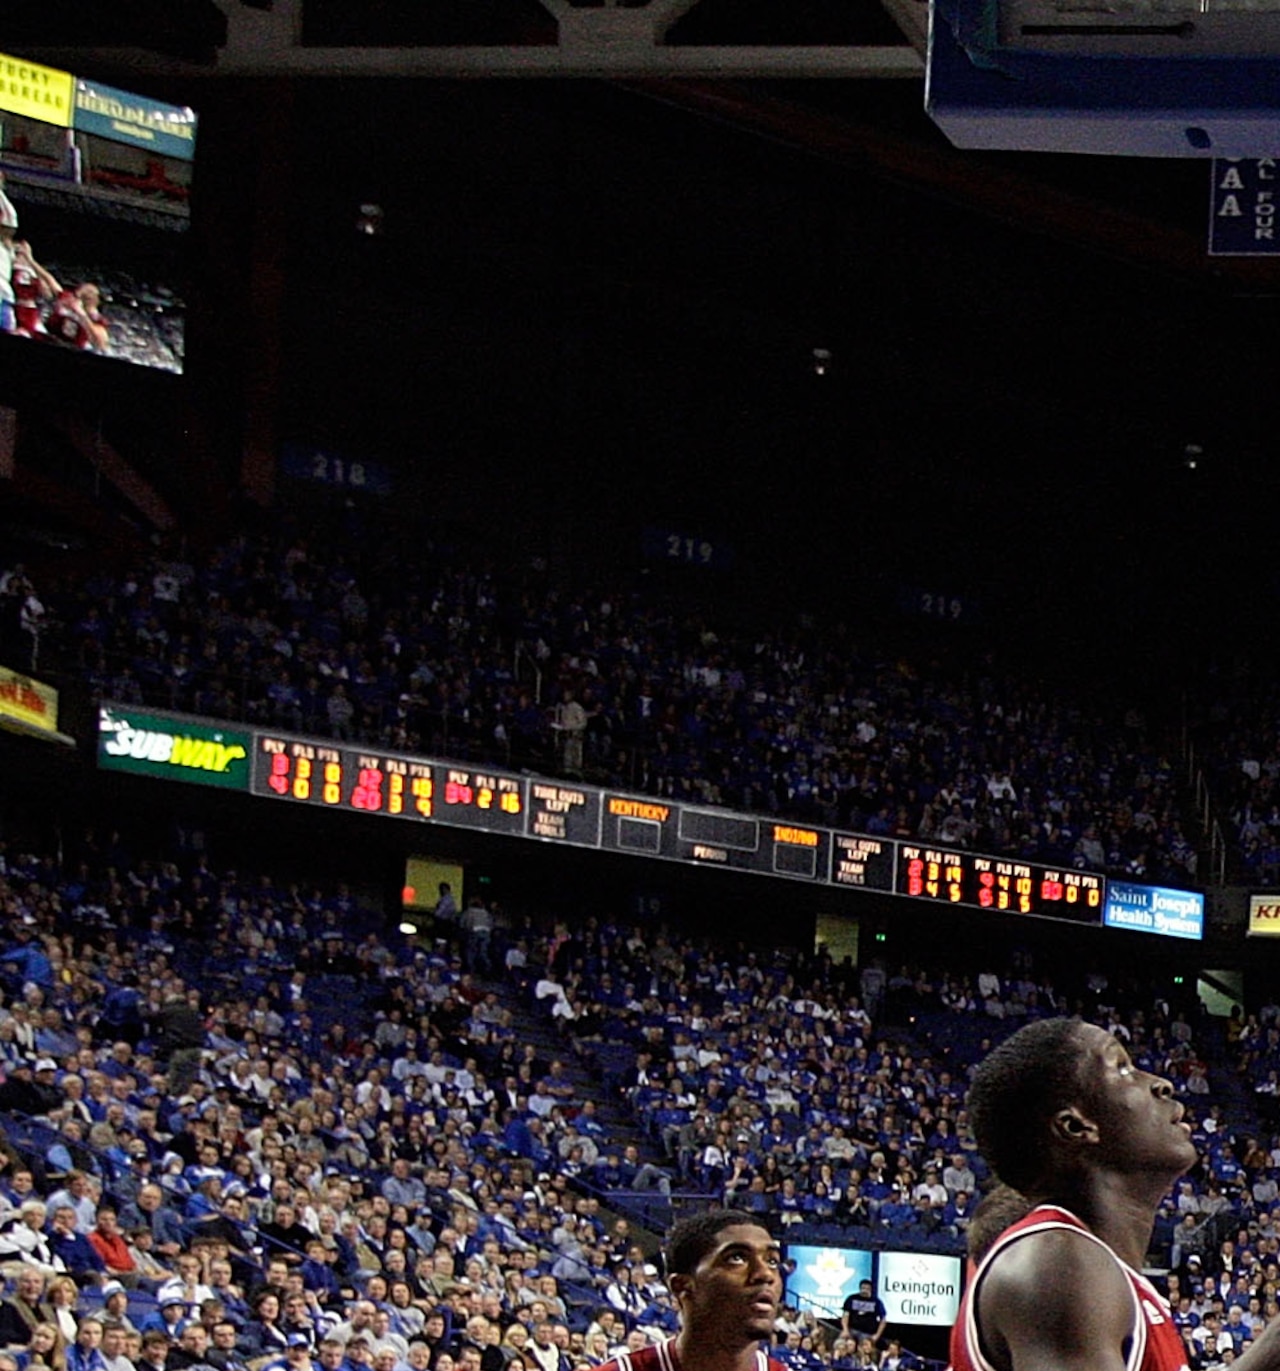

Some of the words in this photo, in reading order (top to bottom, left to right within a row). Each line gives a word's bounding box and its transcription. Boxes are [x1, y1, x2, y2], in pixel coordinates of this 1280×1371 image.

[105, 728, 247, 772] SUBWAY
[609, 799, 670, 822] KENTUCKY
[773, 825, 818, 845] INDIANA
[1109, 886, 1147, 905] Saint
[1151, 892, 1201, 916] Joseph
[1109, 906, 1152, 925] Health
[1153, 911, 1201, 933] System
[884, 1276, 954, 1298] Lexington
[900, 1299, 938, 1317] Clinic
